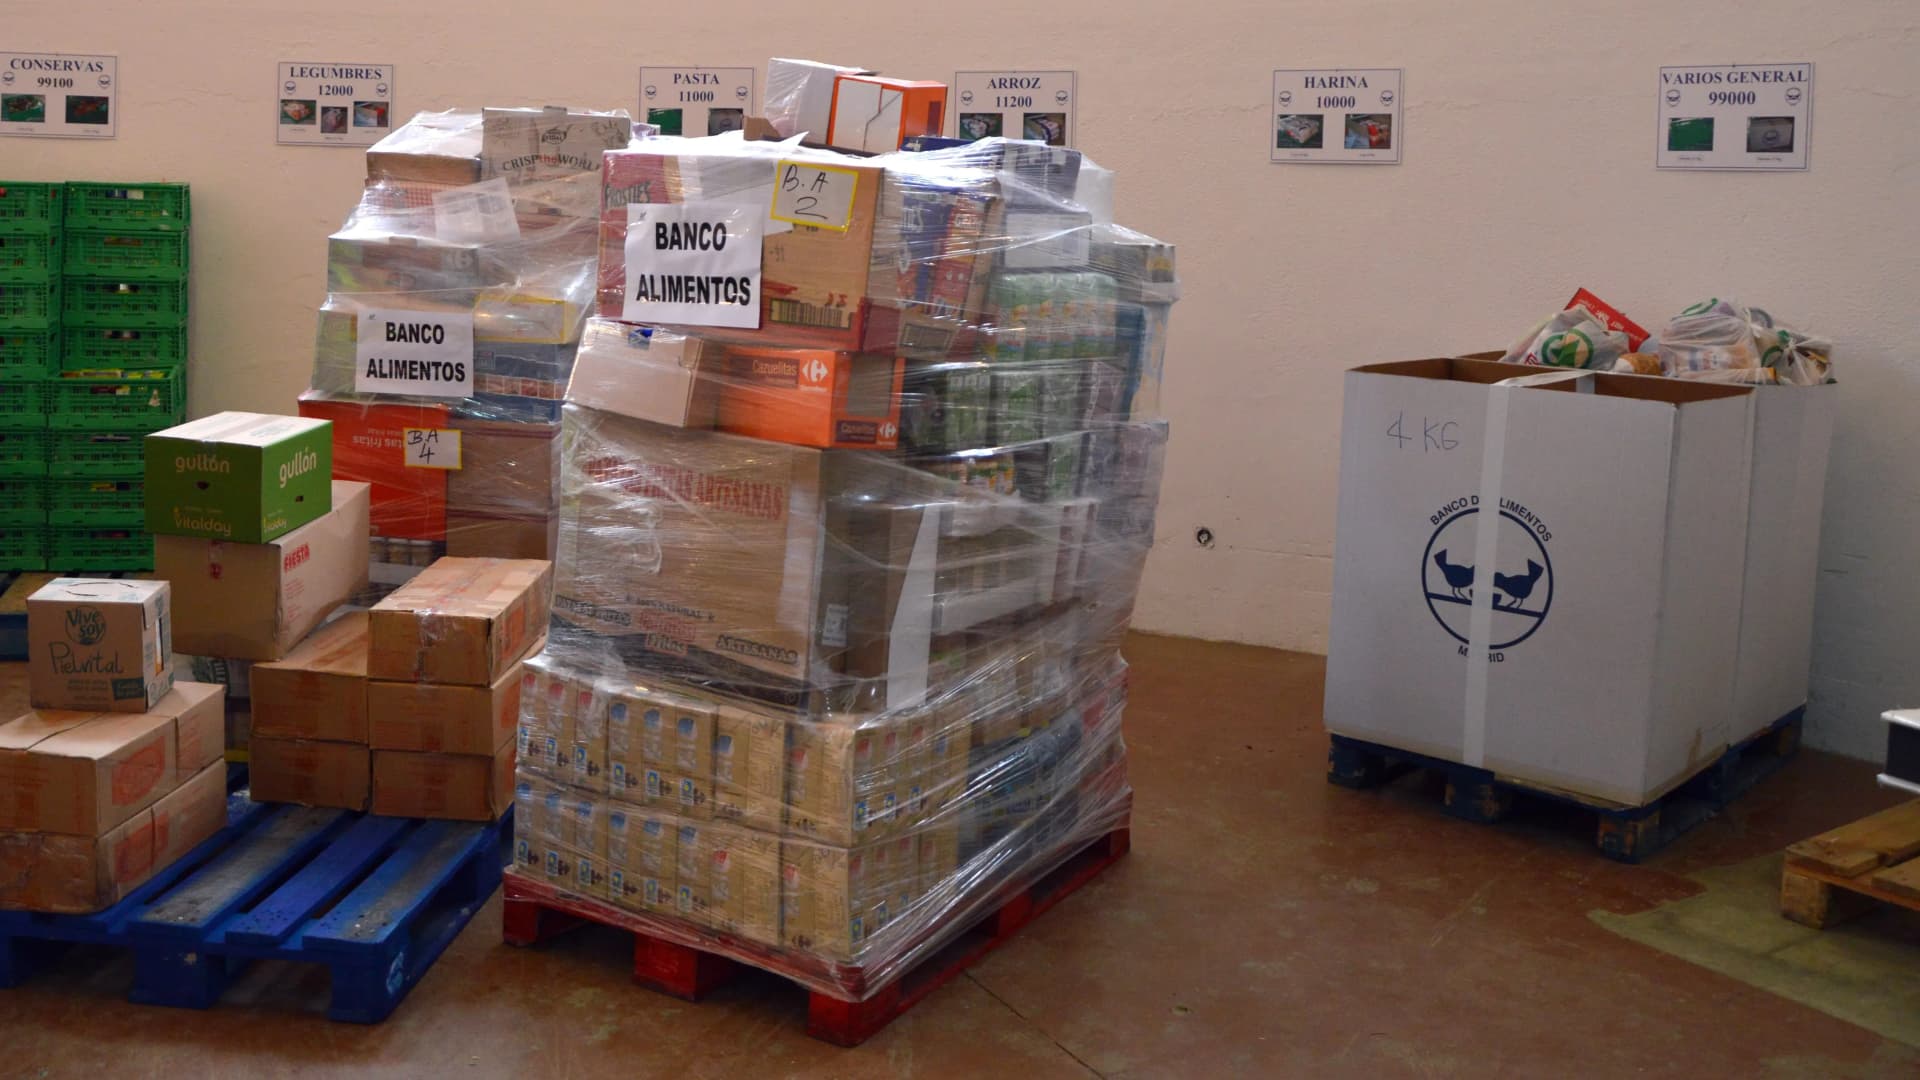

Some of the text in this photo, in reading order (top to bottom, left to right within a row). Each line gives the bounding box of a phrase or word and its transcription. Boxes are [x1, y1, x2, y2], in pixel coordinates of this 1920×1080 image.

[10, 58, 104, 72] CONSERVAS
[289, 66, 383, 79] LEGUMBRES
[37, 77, 74, 88] 99100
[673, 73, 720, 84] PASTA
[987, 77, 1041, 89] ARROZ
[1304, 76, 1368, 89] HARINA
[1662, 70, 1809, 85] VARIOS GENERAL
[319, 85, 353, 96] 12000
[679, 91, 714, 102] 11000
[1708, 91, 1756, 105] 99000
[996, 96, 1032, 108] 11200
[1317, 96, 1356, 108] 10000
[794, 196, 828, 220] 2
[655, 222, 727, 251] BANCO
[636, 274, 751, 306] ALIMENTOS
[385, 321, 445, 345] BANCO
[366, 358, 466, 383] ALIMENTOS
[752, 358, 798, 376] Cazuelitas
[1386, 411, 1459, 453] 4 KG
[418, 443, 435, 464] 4
[175, 455, 230, 473] gullón
[279, 447, 317, 488] gullón
[1430, 497, 1469, 526] BANCO
[1499, 497, 1553, 542] LIMENTOS
